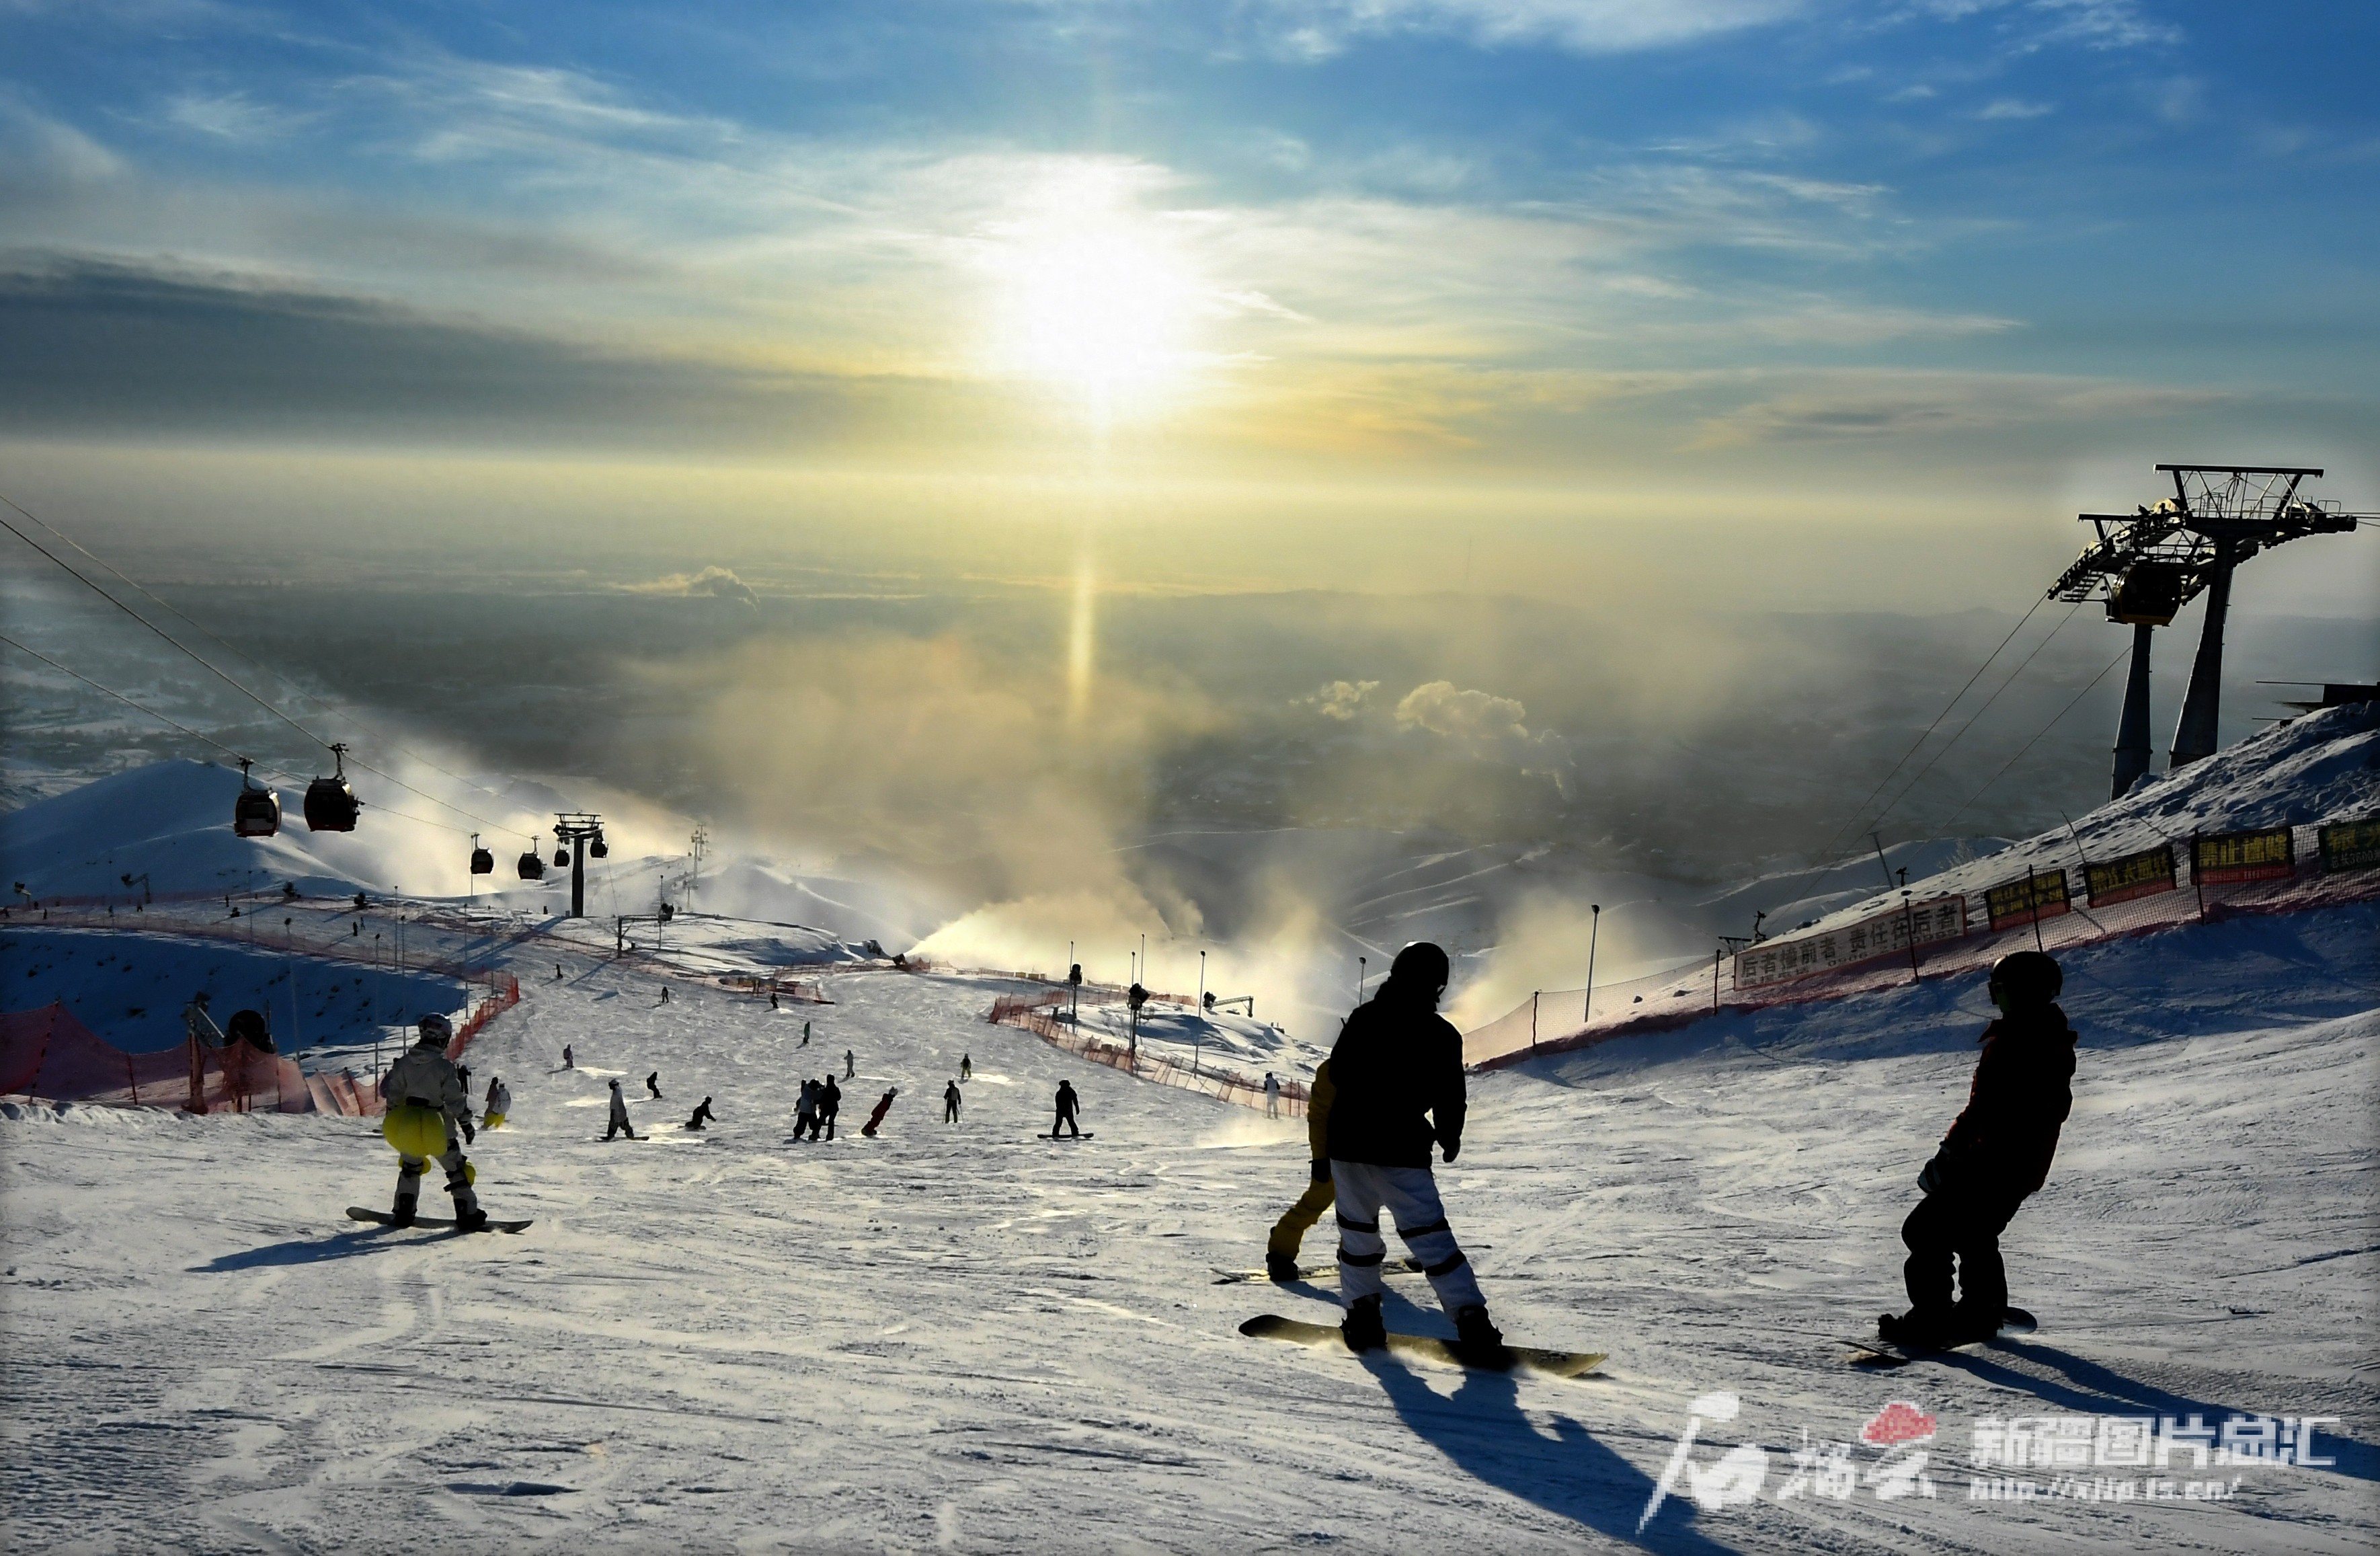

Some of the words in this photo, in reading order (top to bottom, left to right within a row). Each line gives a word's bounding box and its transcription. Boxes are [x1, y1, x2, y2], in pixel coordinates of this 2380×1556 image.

[1741, 936, 1836, 978] 后者撞前者
[1850, 903, 1957, 953] 责任在后者
